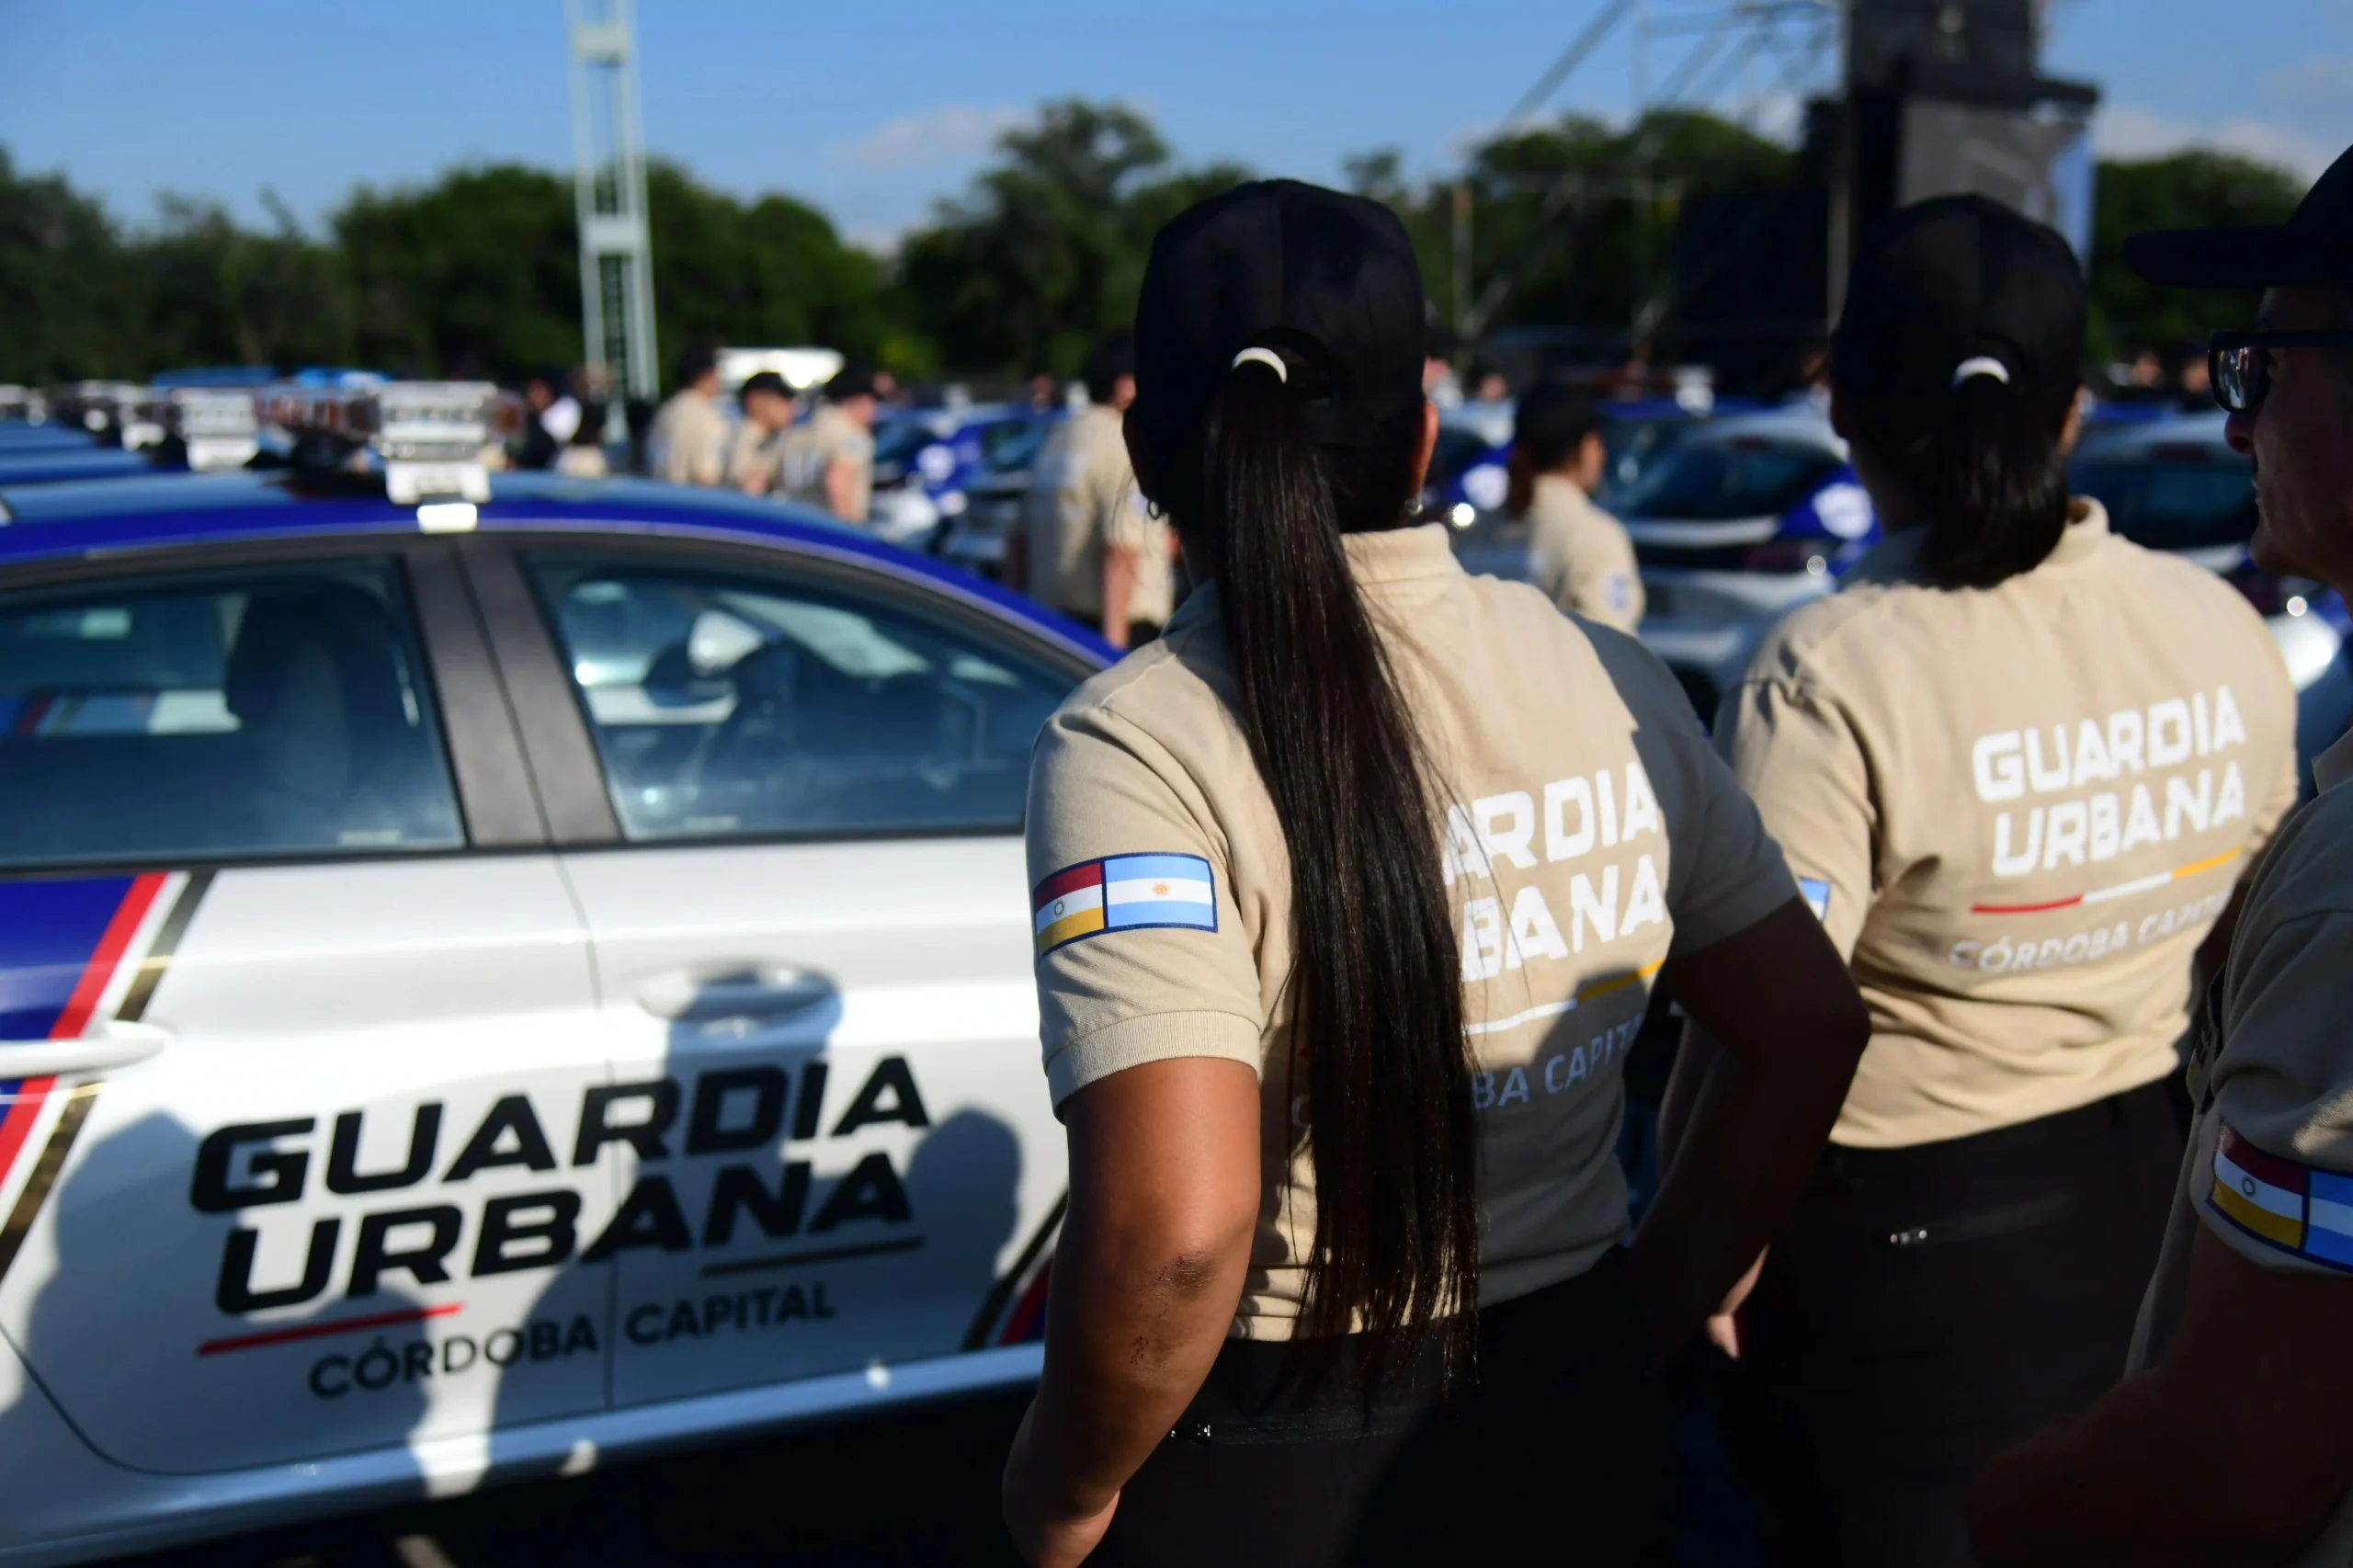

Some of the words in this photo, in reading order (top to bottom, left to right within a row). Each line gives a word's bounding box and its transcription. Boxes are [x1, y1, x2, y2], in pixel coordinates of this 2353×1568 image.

[1972, 684, 2247, 802] GUARDIA
[1443, 761, 1660, 886] ARDIA
[1991, 760, 2246, 878] URBANA
[1461, 854, 1665, 983] BANA
[1949, 920, 2128, 974] CÓRDOBA
[189, 1055, 930, 1213] GUARDIA
[214, 1152, 915, 1315] URBANA
[308, 1313, 598, 1400] CÓRDOBA
[625, 1281, 836, 1346] CAPITAL
